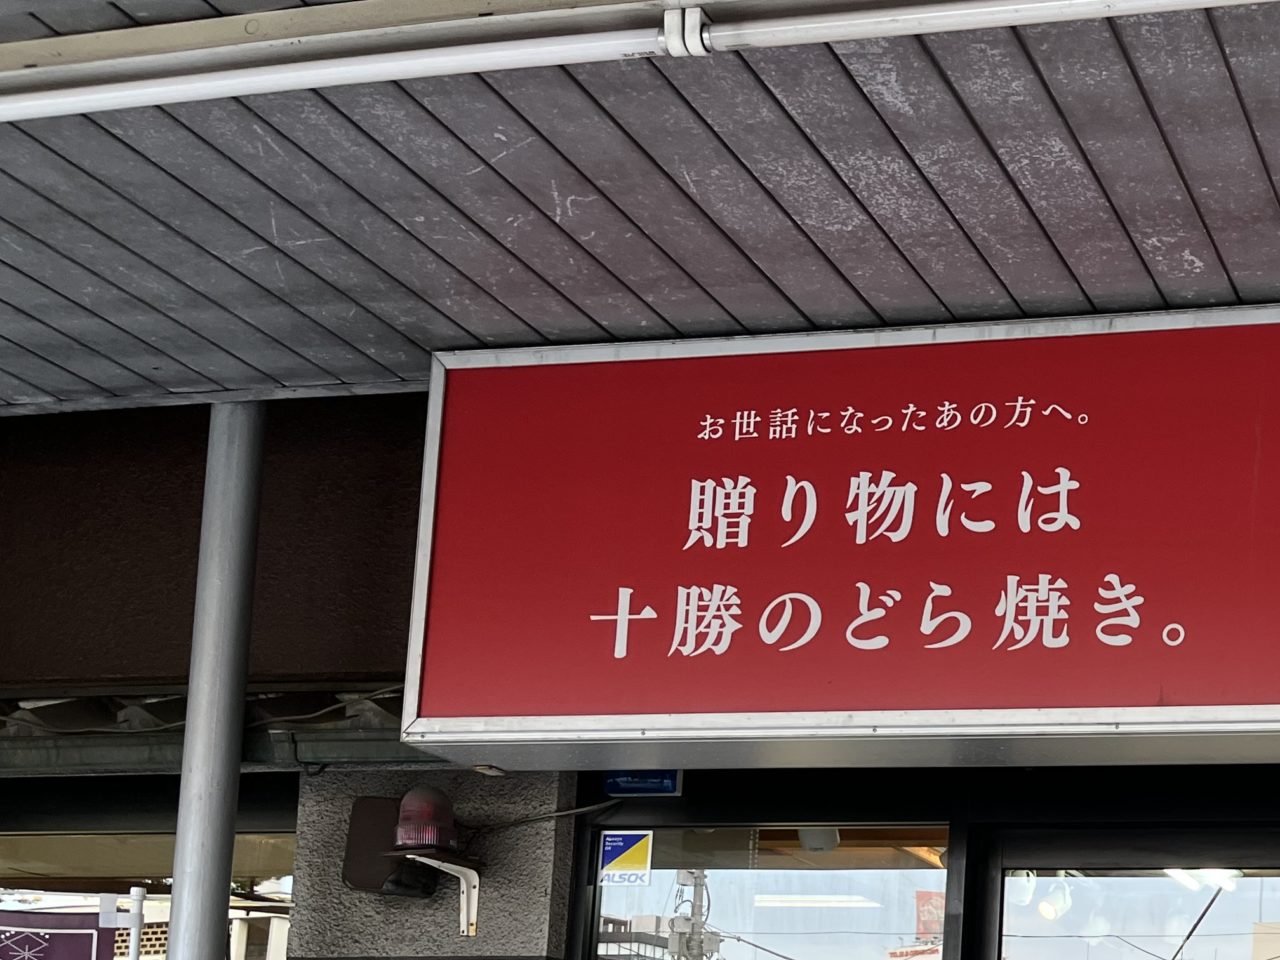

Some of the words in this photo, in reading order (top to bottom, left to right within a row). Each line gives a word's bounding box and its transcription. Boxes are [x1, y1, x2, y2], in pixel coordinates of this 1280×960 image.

[697, 394, 1092, 441] お世話になったあの方へ。
[683, 467, 1082, 552] 贈り物には
[589, 572, 1188, 660] 十勝のどら焼き。
[600, 873, 646, 884] ALSOK
